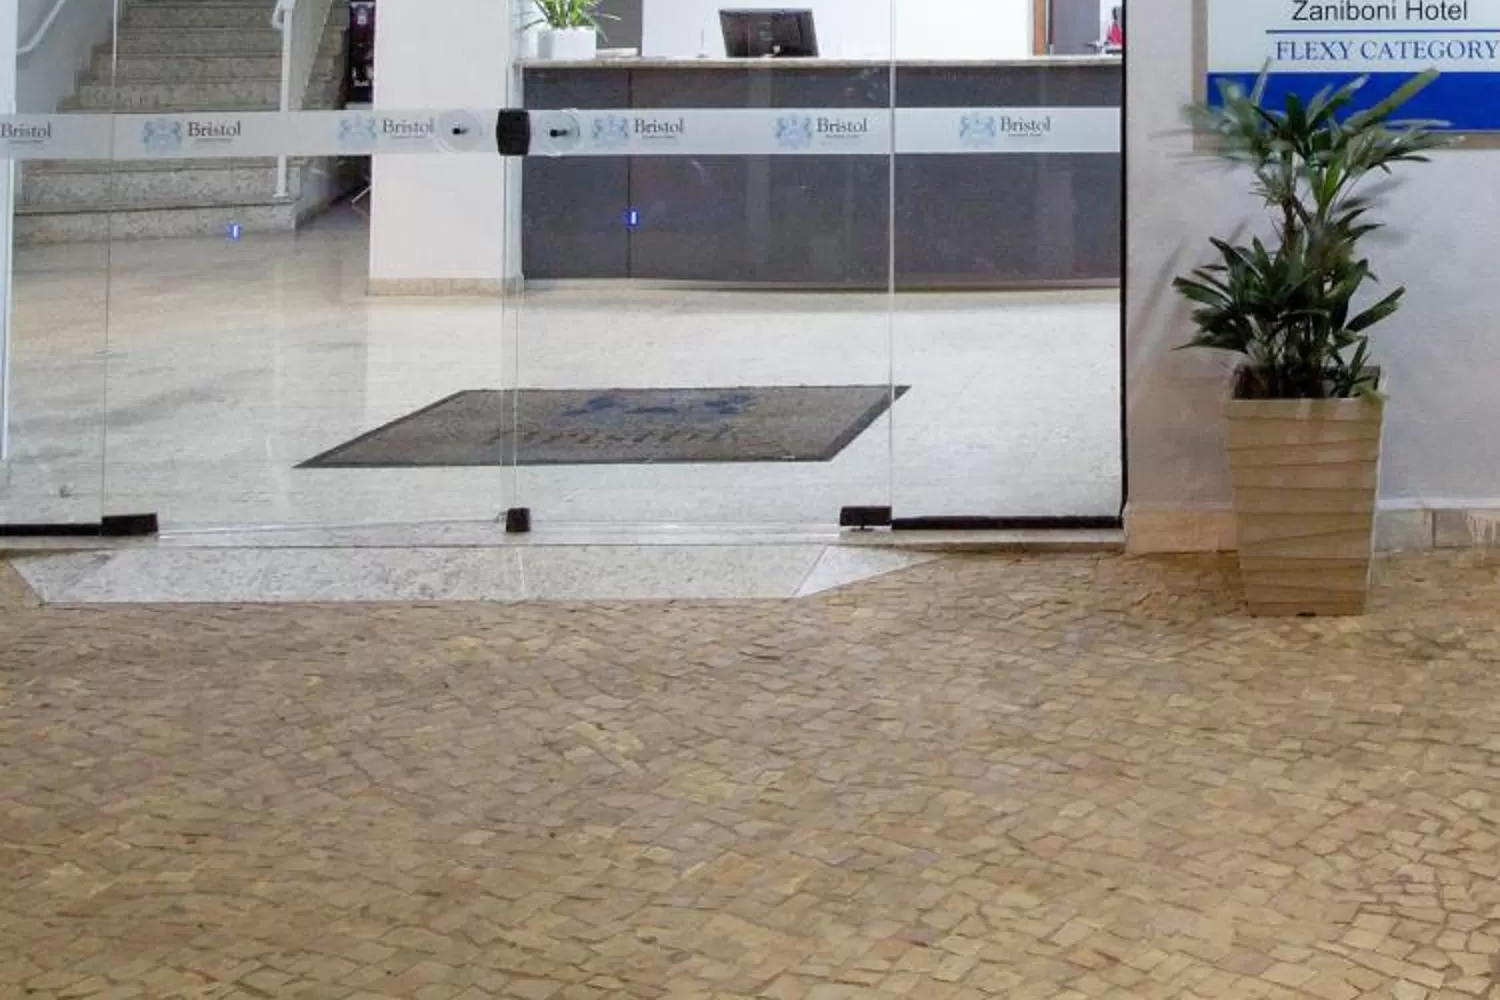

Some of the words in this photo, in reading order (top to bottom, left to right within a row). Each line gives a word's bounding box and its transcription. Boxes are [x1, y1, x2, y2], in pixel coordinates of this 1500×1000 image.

[1292, 0, 1396, 21] Zaniboni
[1405, 0, 1467, 21] Hotel
[1276, 40, 1352, 61] FLEXY
[1361, 39, 1499, 60] CATEGORY
[0, 120, 52, 138] Bristol
[187, 120, 241, 137] Bristol
[382, 117, 434, 134] Bristol
[634, 117, 685, 134] Bristol
[816, 117, 868, 133] Bristol
[1000, 116, 1051, 133] Bristol
